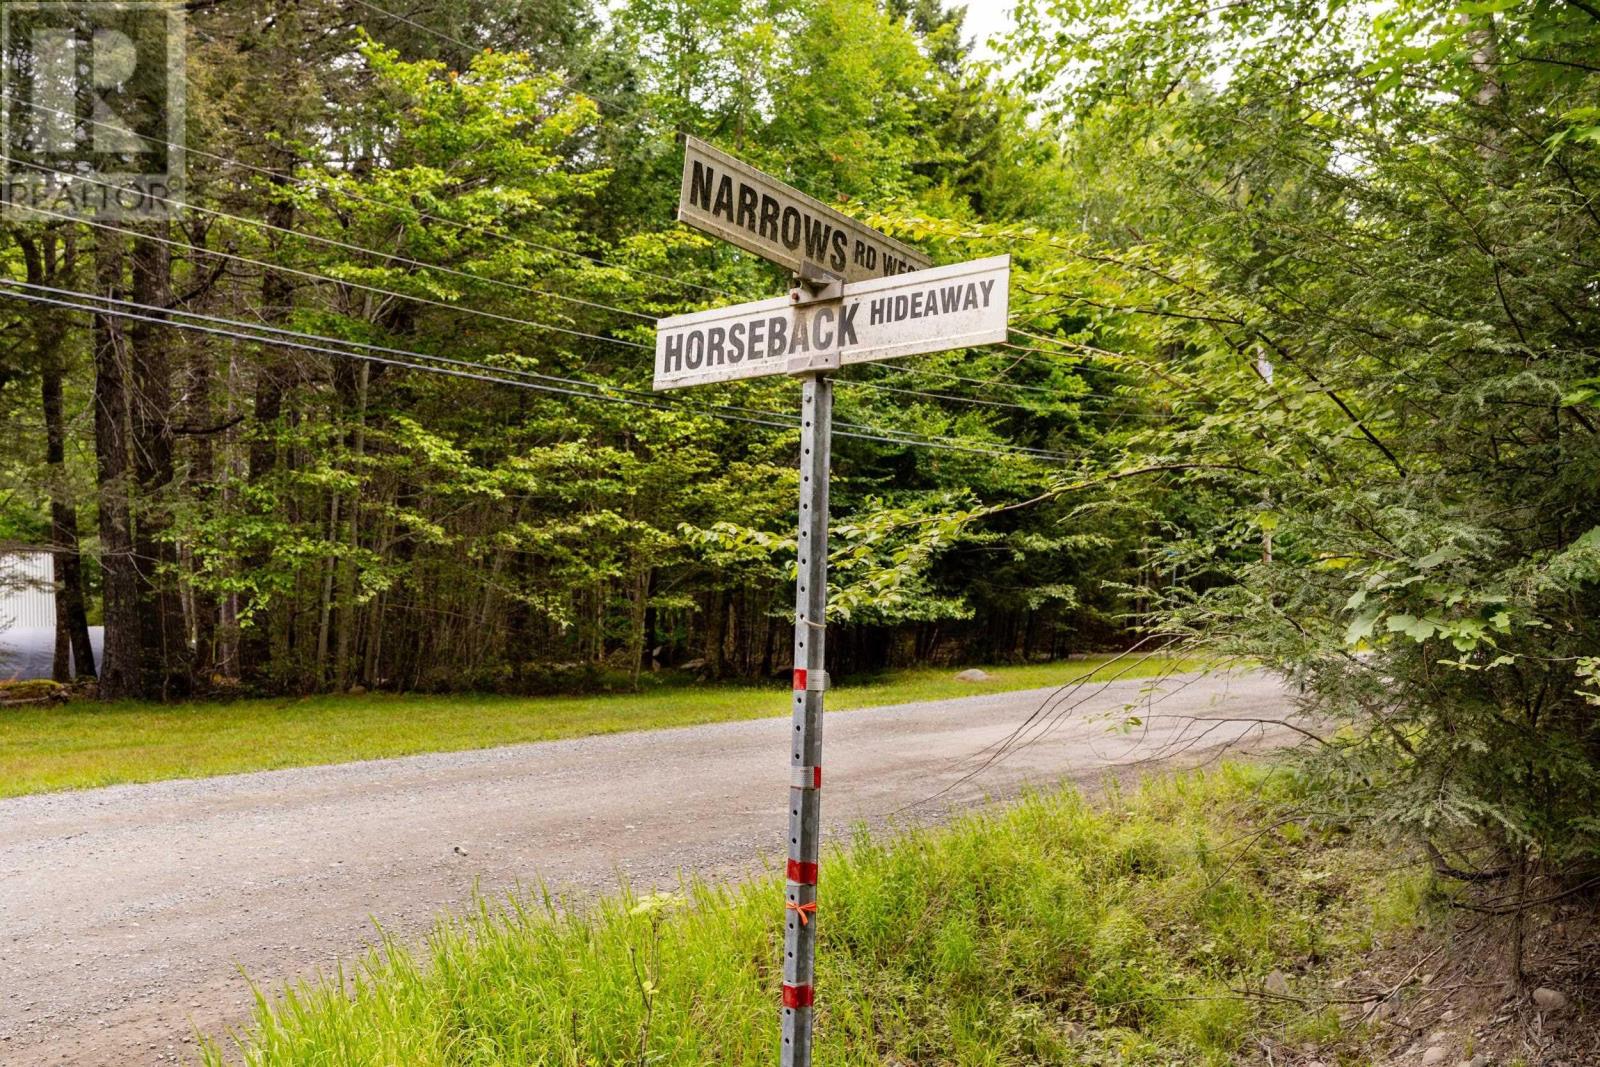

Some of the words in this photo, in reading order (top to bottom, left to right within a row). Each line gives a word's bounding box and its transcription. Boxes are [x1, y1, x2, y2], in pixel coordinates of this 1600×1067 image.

[690, 160, 848, 272] NARROWS
[854, 239, 877, 270] RD
[883, 252, 920, 277] WE
[663, 303, 860, 373] HORSEBACK
[870, 279, 995, 325] HIDEAWAY
